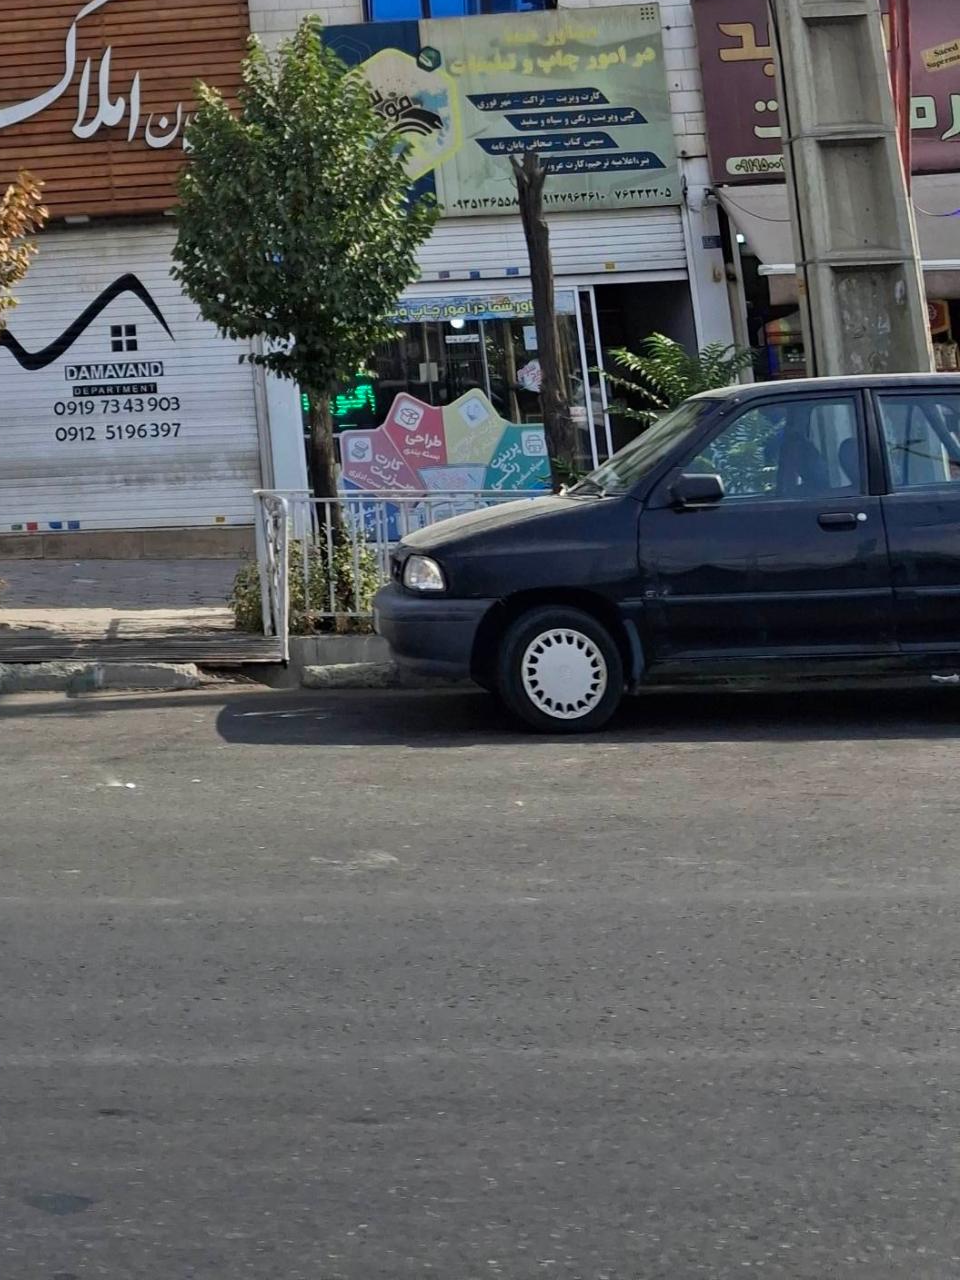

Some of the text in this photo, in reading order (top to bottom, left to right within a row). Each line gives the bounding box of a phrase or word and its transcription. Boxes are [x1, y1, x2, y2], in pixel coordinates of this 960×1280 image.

[66, 362, 163, 380] DAMAVAND
[74, 384, 156, 396] DEPARTMENT
[55, 426, 96, 442] 0912
